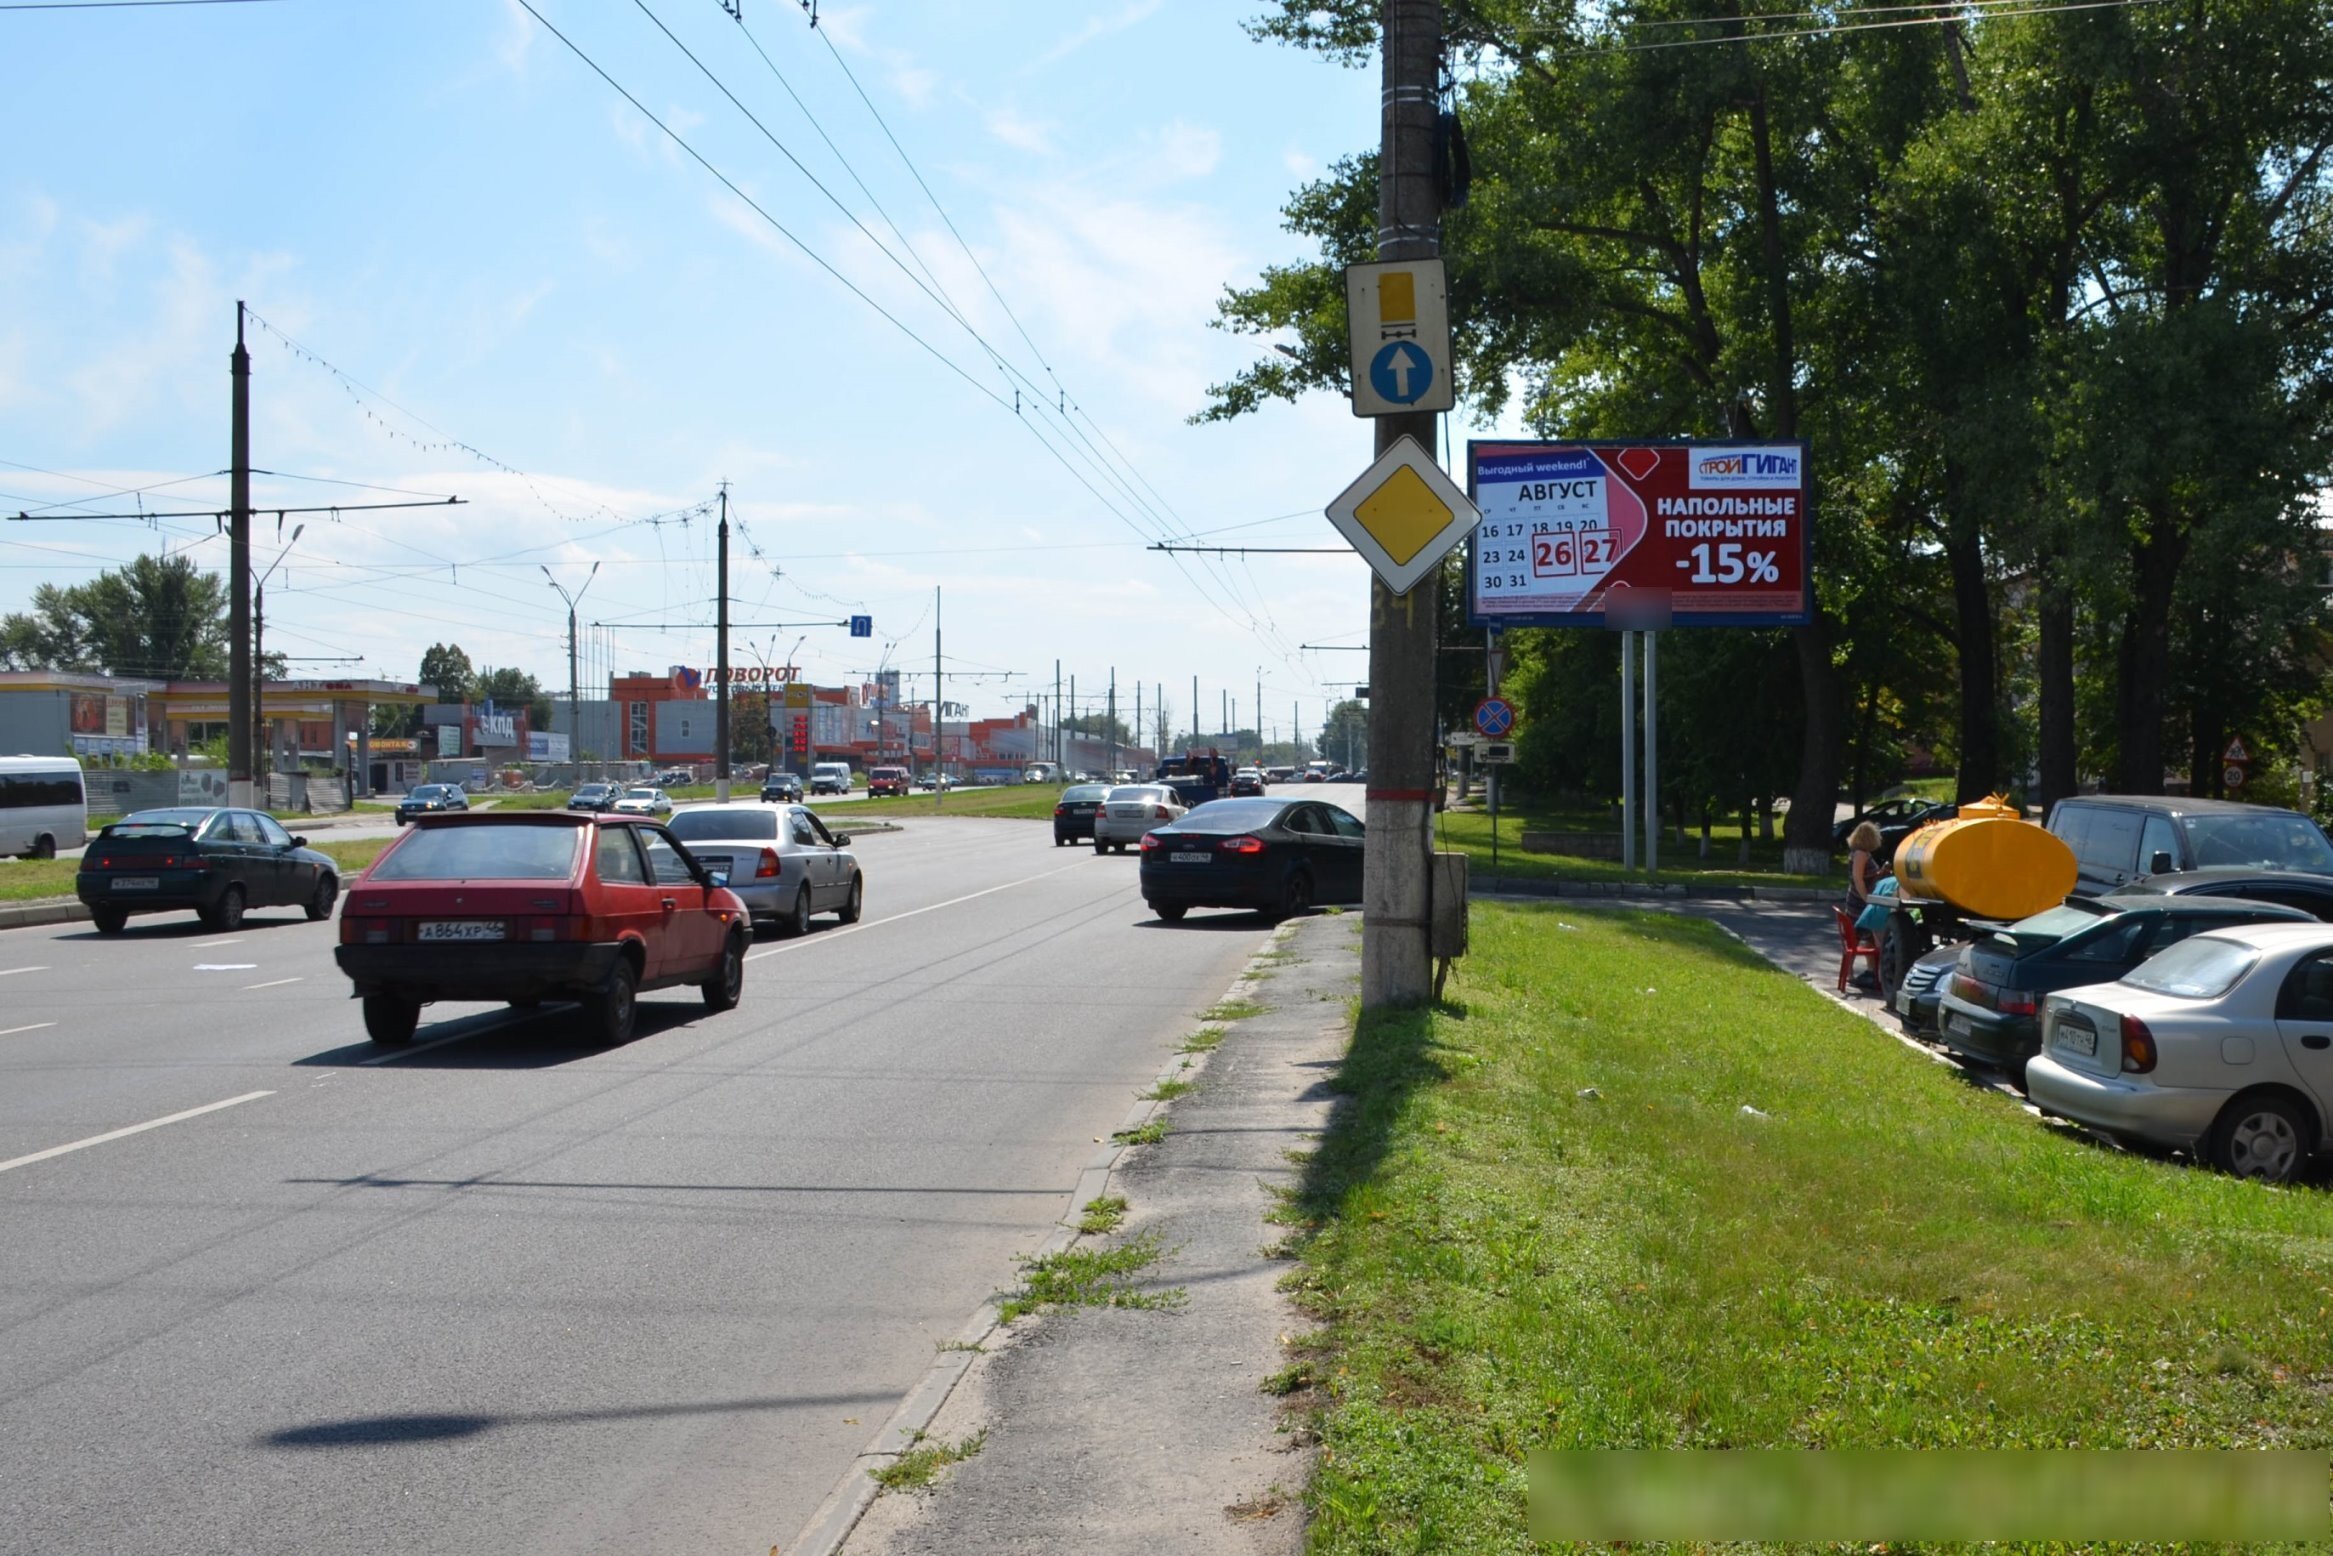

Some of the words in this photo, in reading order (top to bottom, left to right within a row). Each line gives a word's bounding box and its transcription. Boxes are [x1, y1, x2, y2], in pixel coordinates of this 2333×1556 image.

[1478, 463, 1534, 476] Выгодный
[1518, 480, 1597, 502] АВГУСТ
[1657, 497, 1796, 515] НАПОЛЬНЫЕ
[1482, 525, 1499, 538] 16
[1506, 523, 1524, 537] 17
[1532, 521, 1550, 534] 18
[1556, 520, 1574, 532] 19
[1580, 519, 1598, 531] 20
[1665, 519, 1787, 538] ПОКРЫТИЯ
[1483, 550, 1501, 564] 23
[1507, 549, 1526, 562] 24
[1536, 541, 1573, 567] 26
[1583, 538, 1620, 563] 27
[1675, 543, 1780, 584] -15%
[1484, 576, 1503, 589] 30
[1509, 574, 1528, 587] 31
[705, 667, 802, 684] ПОВОРОТ
[490, 715, 514, 738] КПД
[2227, 770, 2240, 781] 20
[424, 923, 481, 938] А864ХР
